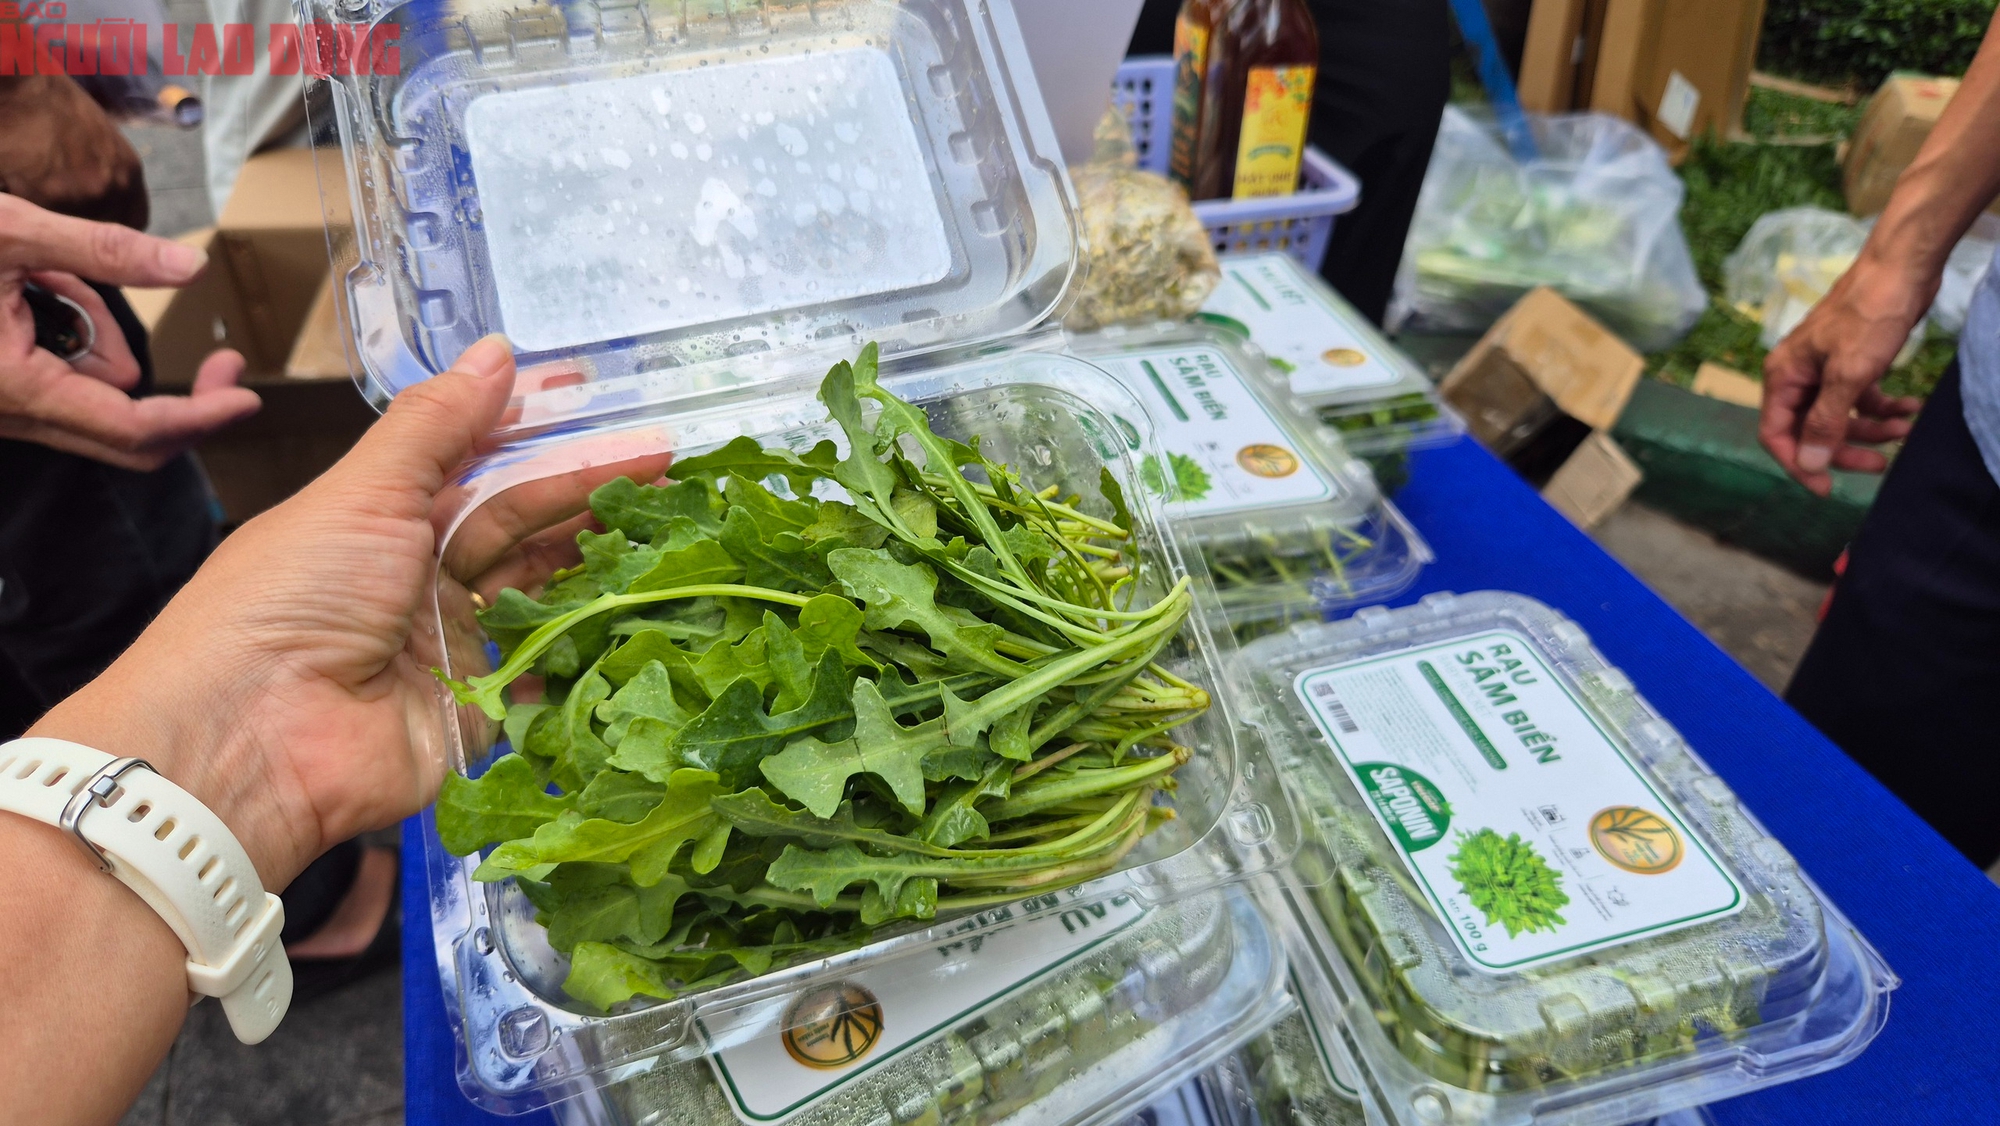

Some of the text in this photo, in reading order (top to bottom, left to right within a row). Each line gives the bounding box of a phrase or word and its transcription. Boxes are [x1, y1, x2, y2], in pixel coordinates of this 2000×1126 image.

[1168, 357, 1206, 389] SÂM
[1194, 354, 1223, 378] RAU
[1486, 643, 1538, 685] RAU
[1455, 650, 1518, 707] SÂM
[1501, 709, 1562, 765] BIỂN
[1369, 766, 1439, 841] SAPONIN
[1460, 913, 1483, 939] 100
[1473, 942, 1489, 953] g
